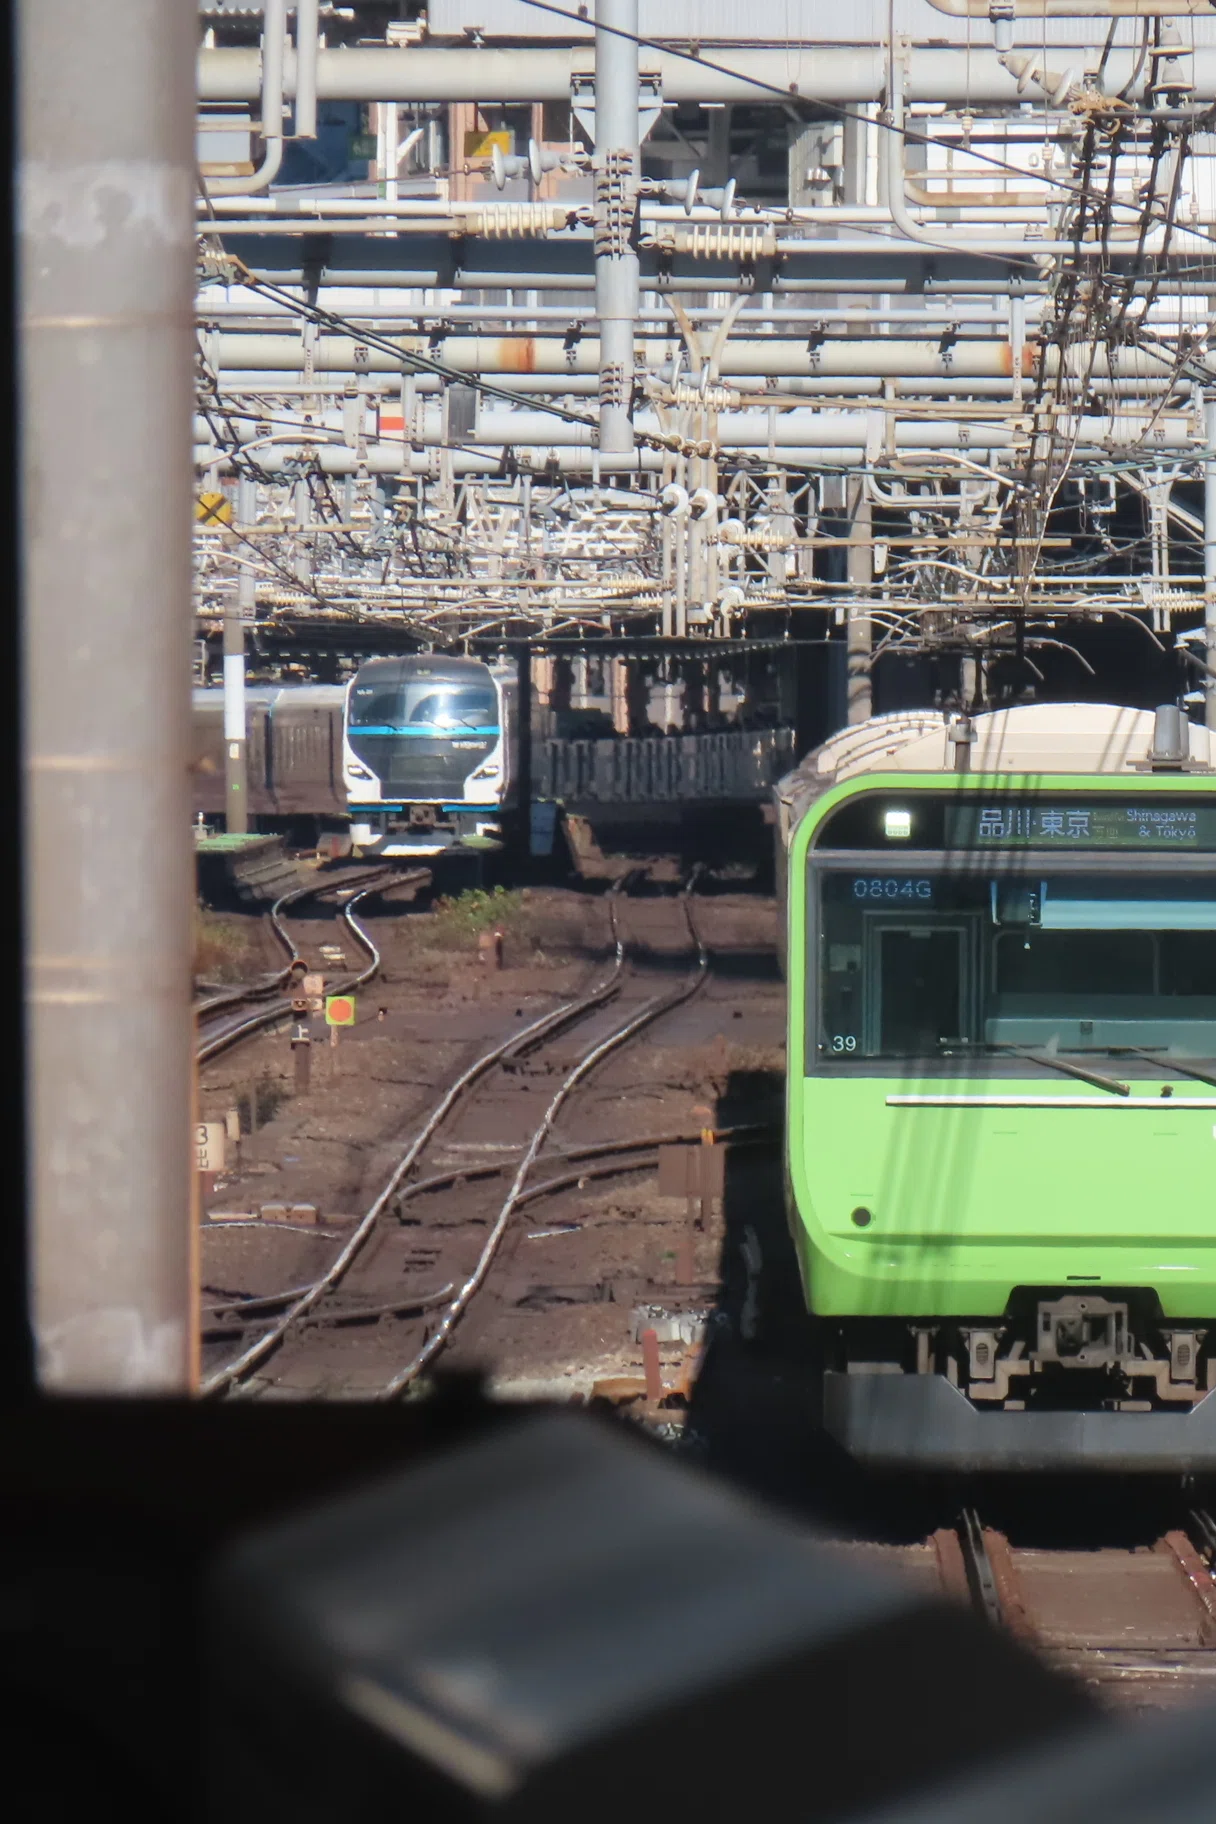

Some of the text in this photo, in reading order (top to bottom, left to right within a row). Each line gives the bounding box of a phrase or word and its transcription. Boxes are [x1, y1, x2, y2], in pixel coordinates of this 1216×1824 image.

[1126, 808, 1197, 824] Shinagawa
[1138, 825, 1152, 838] &
[854, 879, 932, 898] 0804G
[832, 1035, 857, 1052] 39
